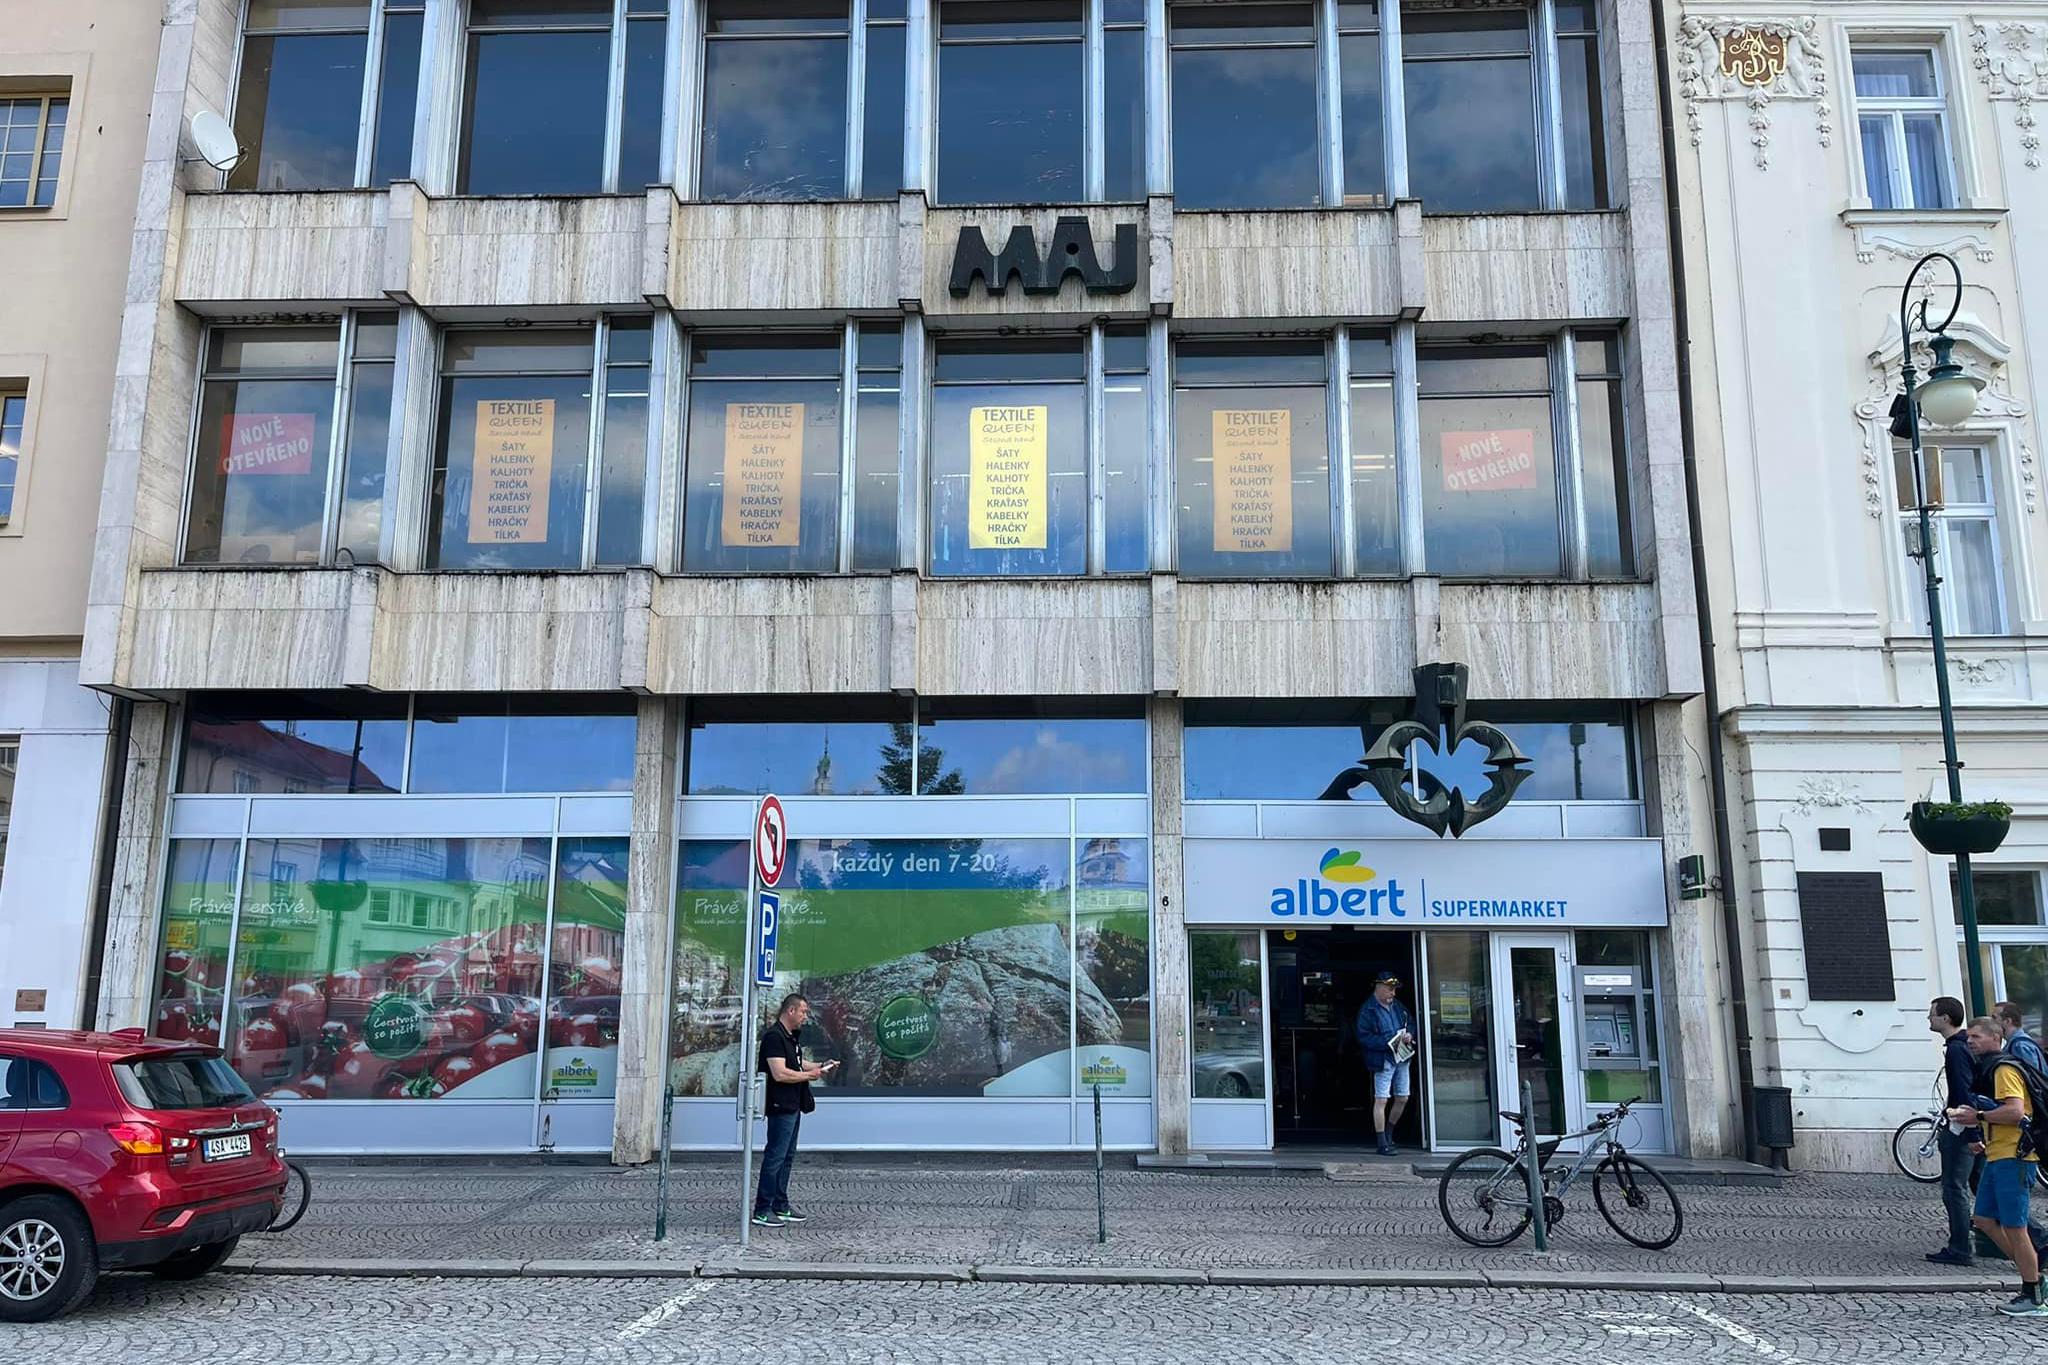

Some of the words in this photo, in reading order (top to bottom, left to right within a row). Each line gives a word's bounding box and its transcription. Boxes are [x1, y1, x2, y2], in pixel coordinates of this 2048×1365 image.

[490, 402, 543, 415] TEXTILE
[739, 406, 793, 418] TEXTILE
[982, 409, 1035, 421] TEXTILE
[1225, 412, 1278, 425] TEXTILE
[489, 417, 543, 427] QUEEN
[739, 420, 792, 430] QUEEN
[982, 424, 1035, 433] QUEEN
[1225, 427, 1278, 437] QUEEN
[501, 442, 526, 452] ŠATY
[752, 444, 776, 455] ŠATY
[222, 438, 309, 474] OTEVŘENO
[996, 447, 1020, 458] ŠATY
[490, 455, 535, 464] HALENKY
[741, 459, 786, 467] HALENKY
[986, 461, 1030, 470] HALENKY
[1230, 465, 1274, 473] HALENKY
[490, 468, 534, 477] KALHOTY
[741, 471, 785, 480] KALHOTY
[1447, 453, 1531, 489] OTEVŘENO
[986, 474, 1030, 483] KALHOTY
[1230, 477, 1273, 486] KALHOTY
[487, 505, 531, 514] KABELKY
[740, 509, 783, 518] KABELKY
[986, 511, 1029, 520] KABELKY
[1231, 514, 1273, 523] KABELKY
[488, 517, 529, 527] HRAČKY
[741, 520, 781, 530] HRAČKY
[988, 523, 1027, 532] HRAČKY
[1232, 526, 1272, 536] HRAČKY
[832, 852, 894, 877] každý
[902, 853, 940, 872] den
[949, 854, 995, 873] 7-20
[1162, 895, 1169, 907] 6
[1270, 878, 1406, 917] albert
[188, 897, 236, 914] Právě
[694, 897, 739, 915] Právě
[1432, 899, 1568, 919] SUPERMARKET
[761, 902, 775, 955] P
[374, 1031, 386, 1040] se
[885, 1031, 897, 1039] se
[558, 1065, 593, 1076] albert
[1087, 1063, 1121, 1075] albert
[211, 1137, 225, 1154] 4SA
[230, 1135, 248, 1152] 4429
